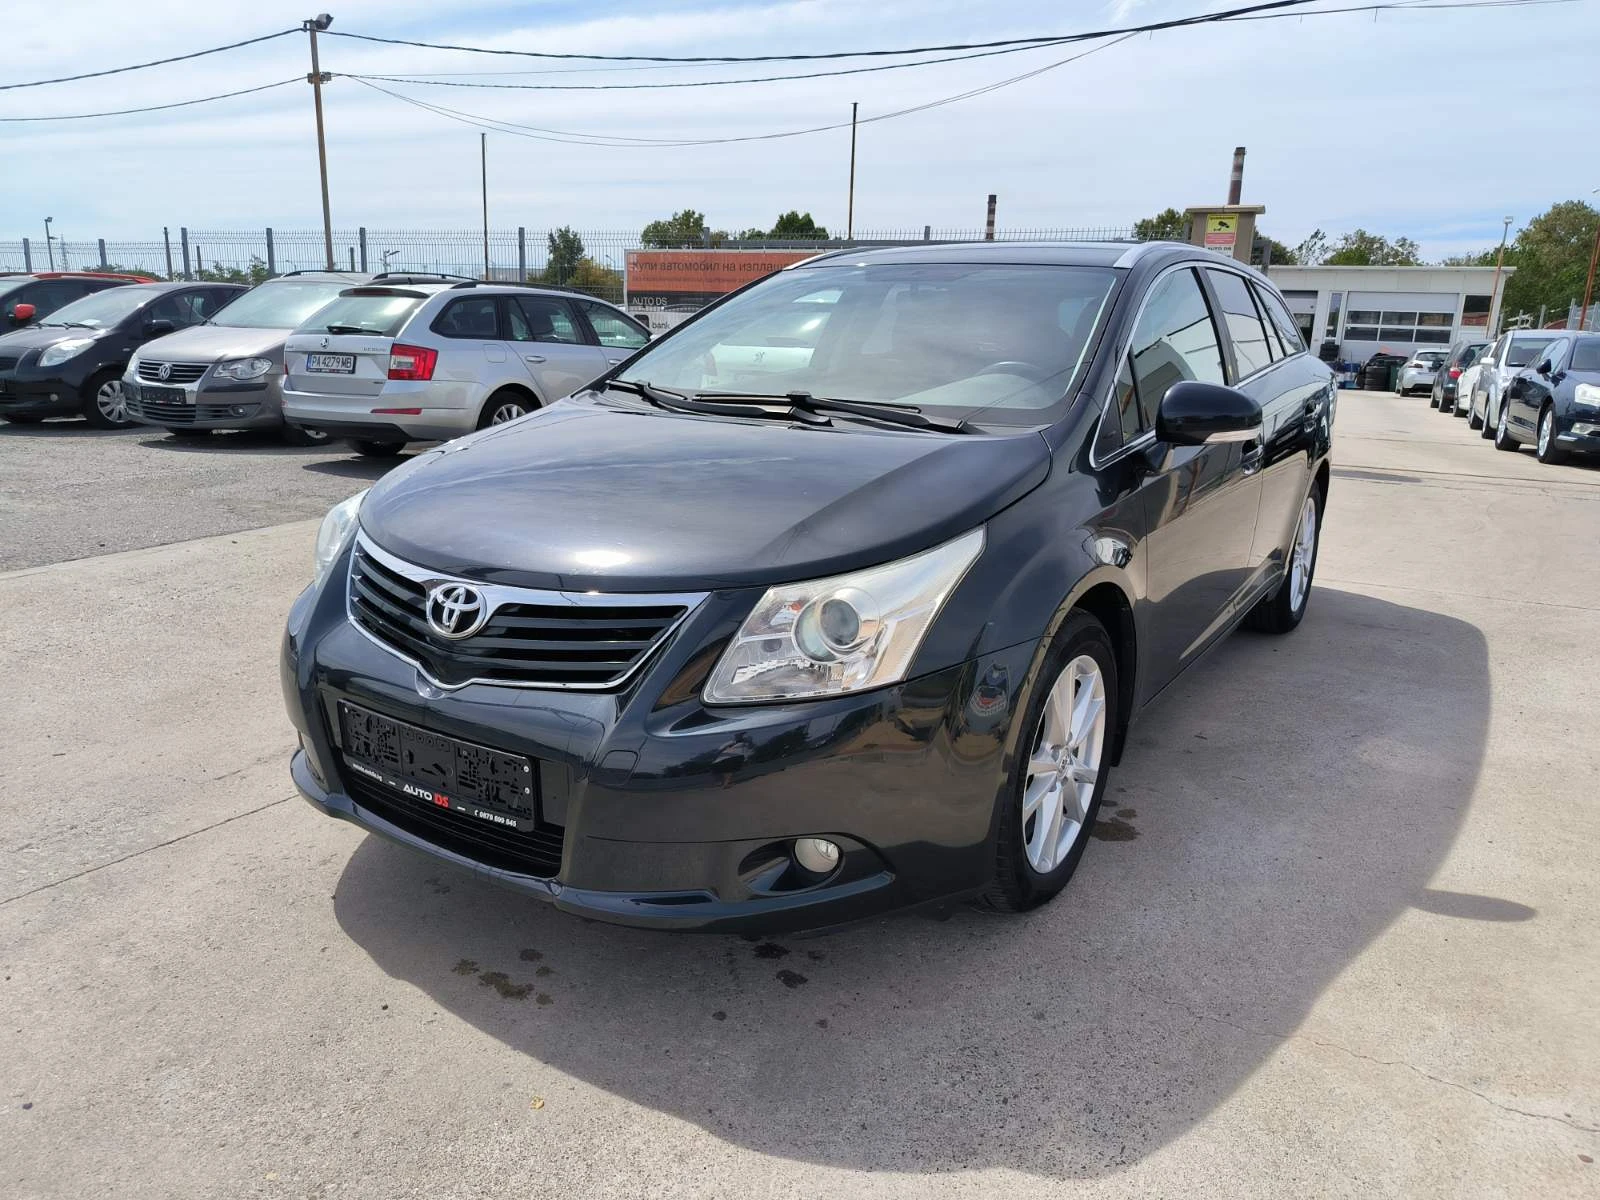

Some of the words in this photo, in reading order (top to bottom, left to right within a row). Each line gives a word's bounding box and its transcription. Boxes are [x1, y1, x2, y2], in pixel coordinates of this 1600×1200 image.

[660, 261, 720, 272] автомобил
[722, 262, 736, 272] на
[632, 297, 655, 305] AUTO
[655, 297, 668, 305] DS
[402, 783, 433, 801] AUTO
[433, 791, 449, 808] DS
